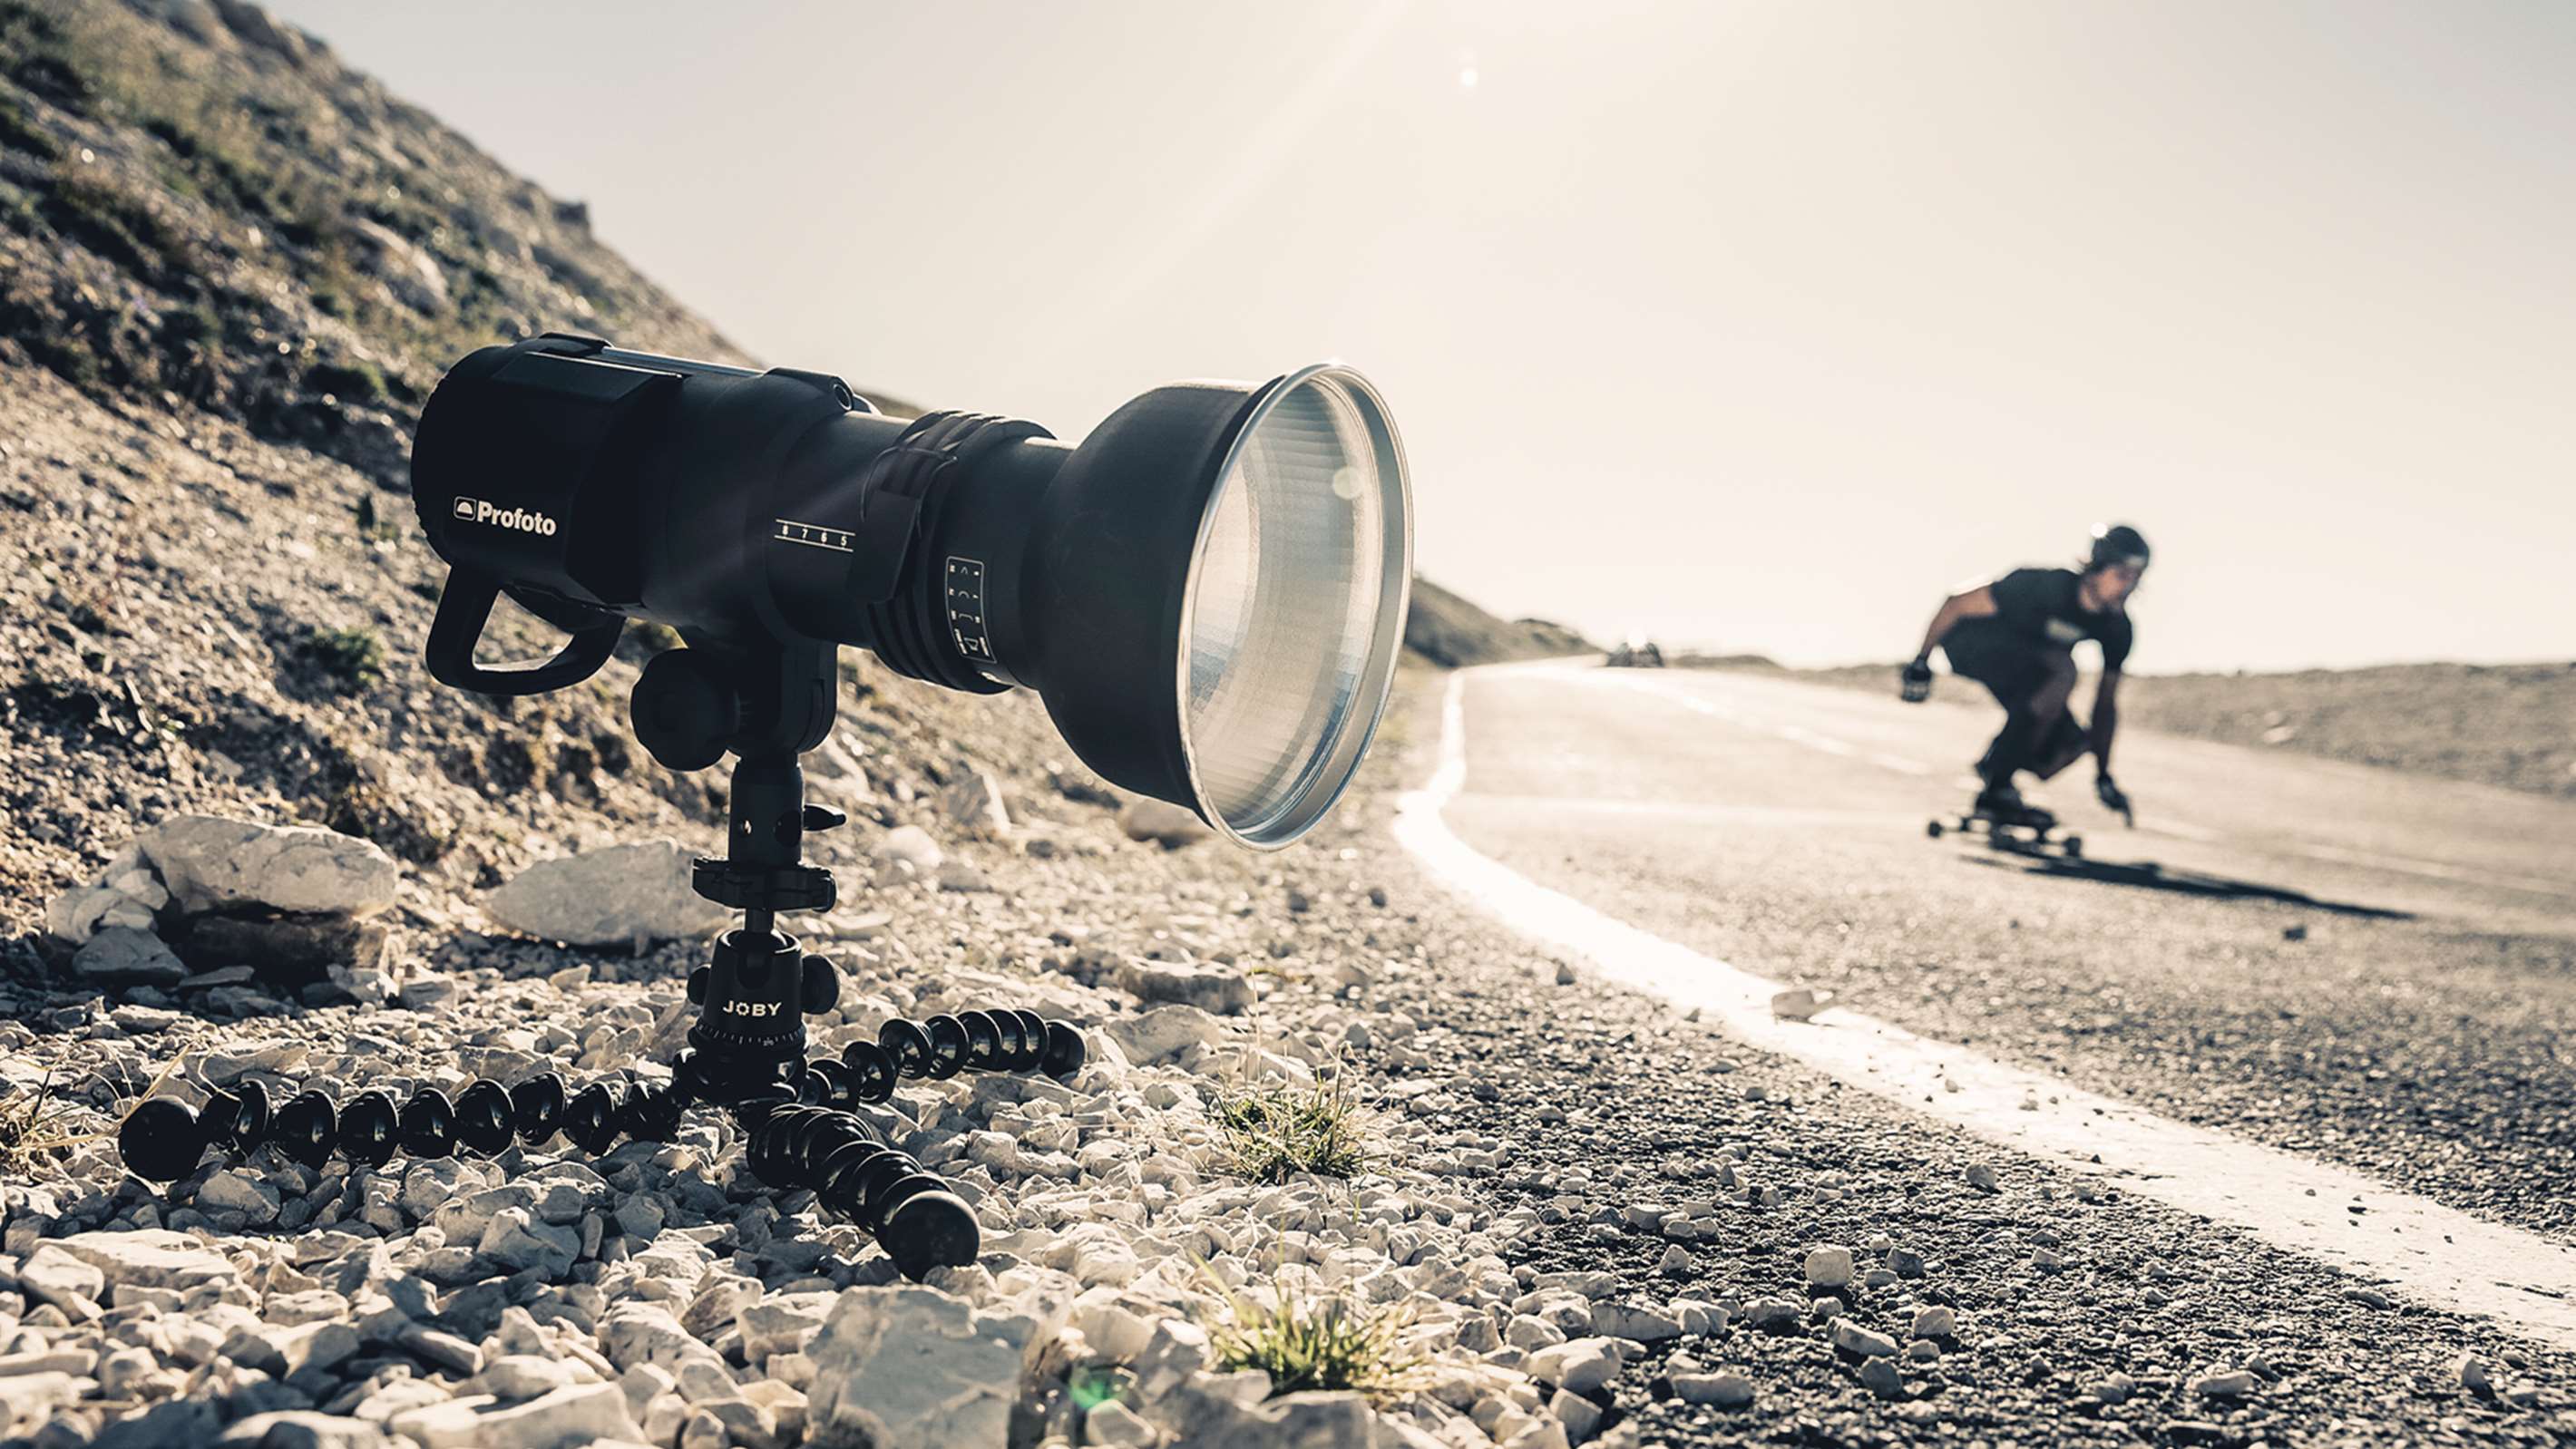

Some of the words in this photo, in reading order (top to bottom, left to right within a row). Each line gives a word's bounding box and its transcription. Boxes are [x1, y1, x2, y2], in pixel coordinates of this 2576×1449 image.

[477, 501, 556, 536] Profoto
[782, 524, 789, 536] 8
[802, 528, 808, 540] 7
[821, 531, 827, 543] 6
[840, 535, 847, 547] 5
[723, 1000, 782, 1016] JOBY
